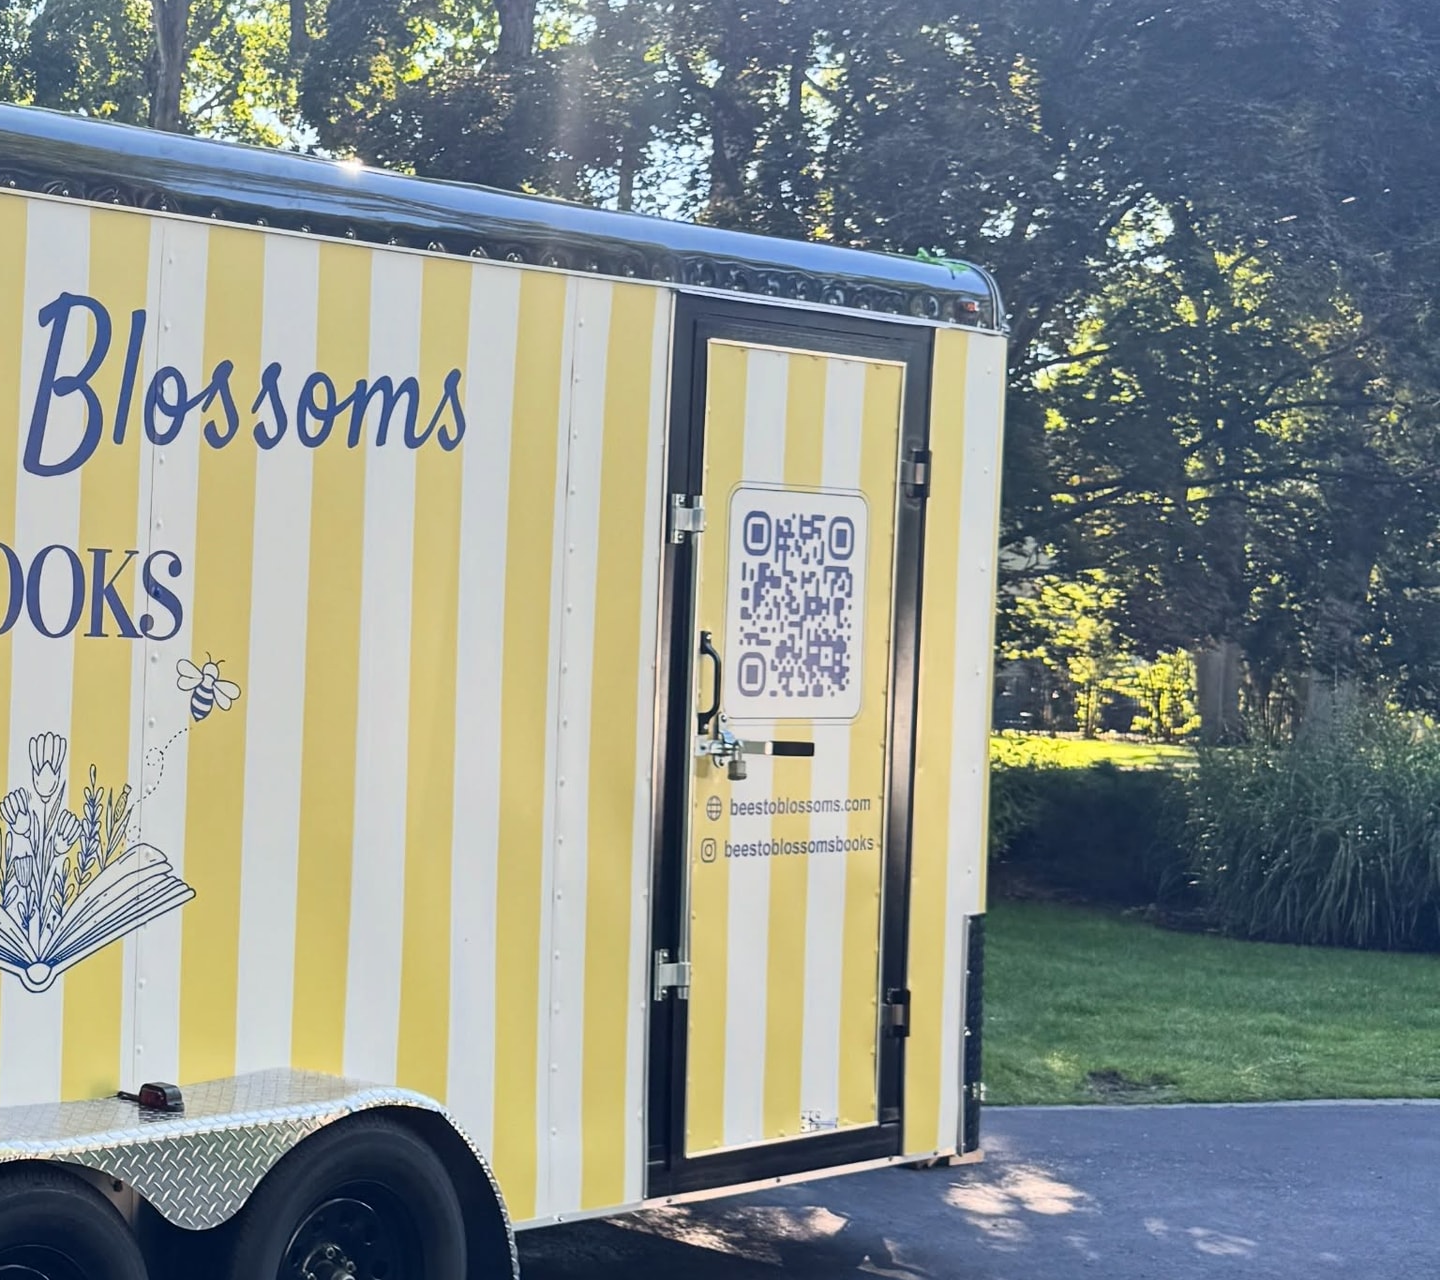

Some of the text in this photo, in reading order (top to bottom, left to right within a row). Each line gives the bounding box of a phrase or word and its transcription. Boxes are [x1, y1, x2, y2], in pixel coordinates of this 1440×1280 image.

[23, 291, 467, 477] Blossoms
[730, 797, 871, 816] beestoblossoms.com
[724, 834, 875, 858] beestoblossomsbooks
